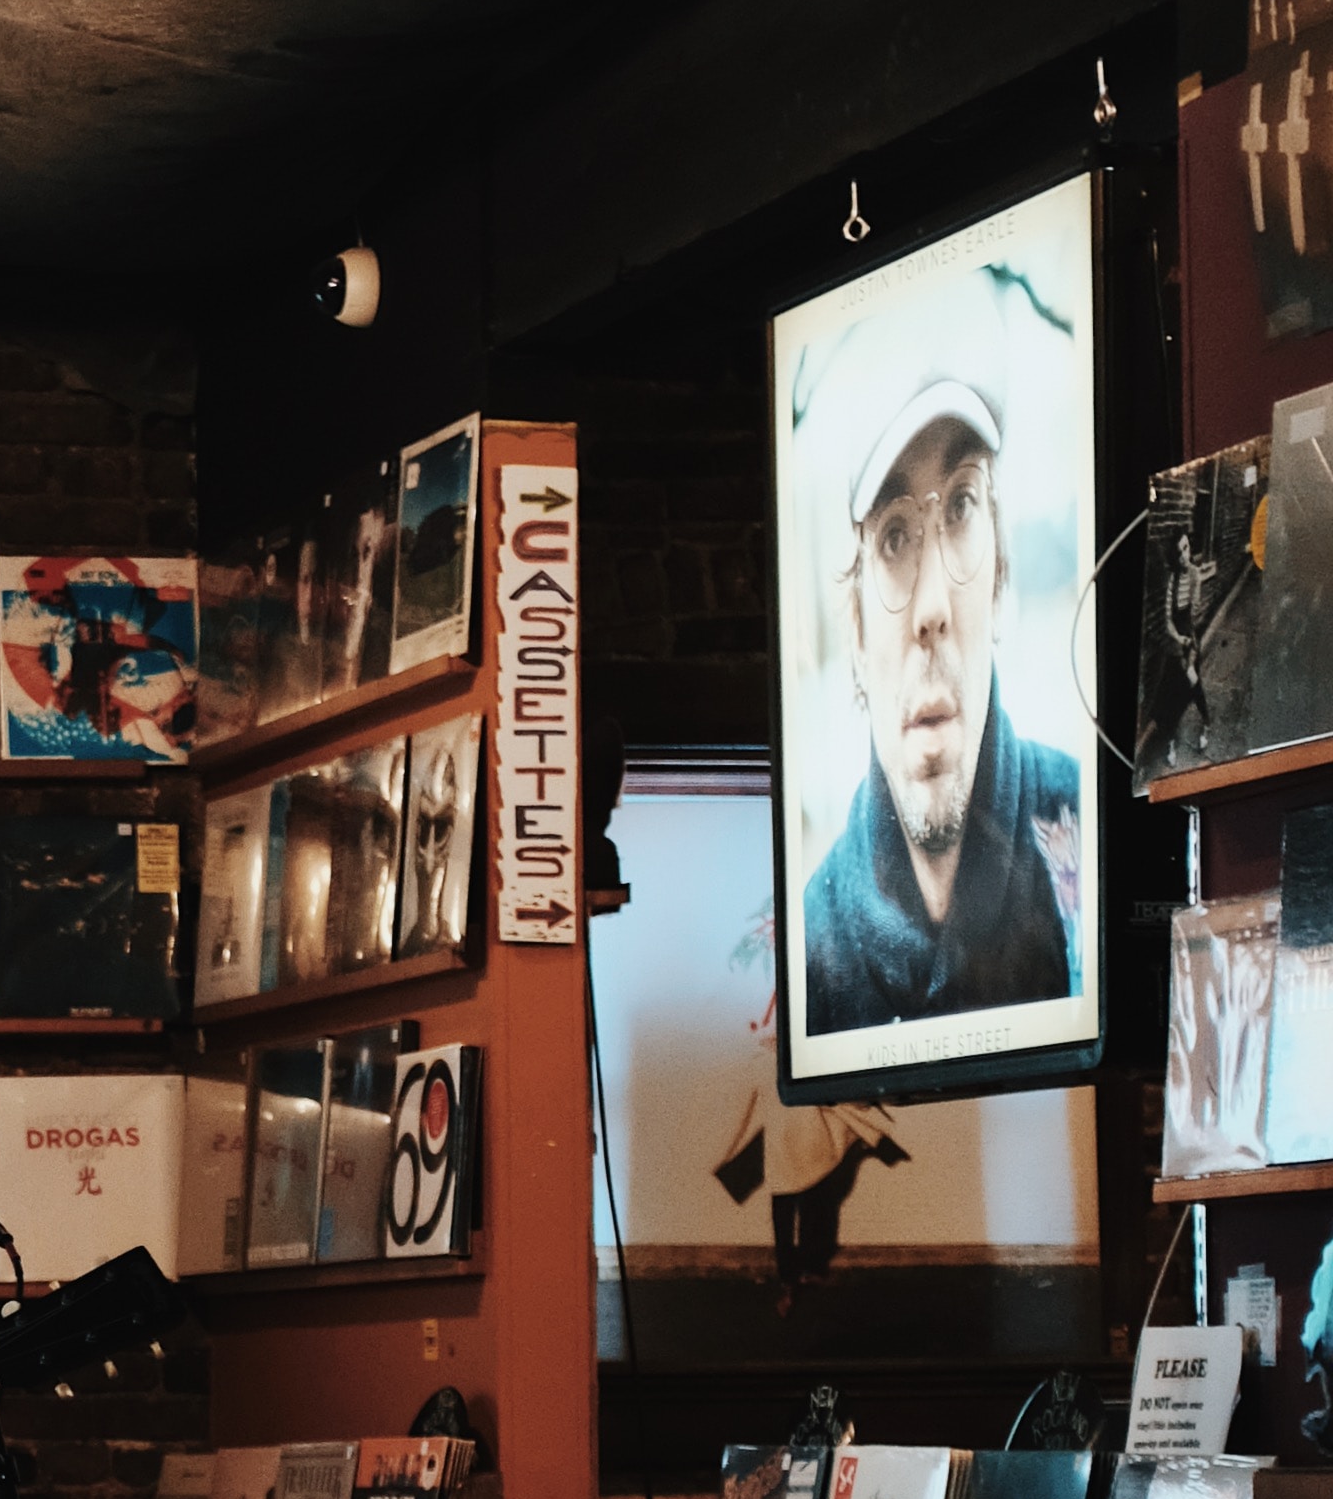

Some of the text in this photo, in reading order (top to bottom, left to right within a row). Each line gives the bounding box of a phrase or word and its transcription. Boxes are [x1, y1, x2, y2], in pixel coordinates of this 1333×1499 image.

[840, 212, 1016, 310] JUSTIN TOWNES EARLE
[508, 520, 577, 880] CASSETTES
[867, 1028, 1011, 1068] KIDS IN THE STREET
[26, 1127, 141, 1150] DROGAS
[1154, 1357, 1208, 1380] PLEASE
